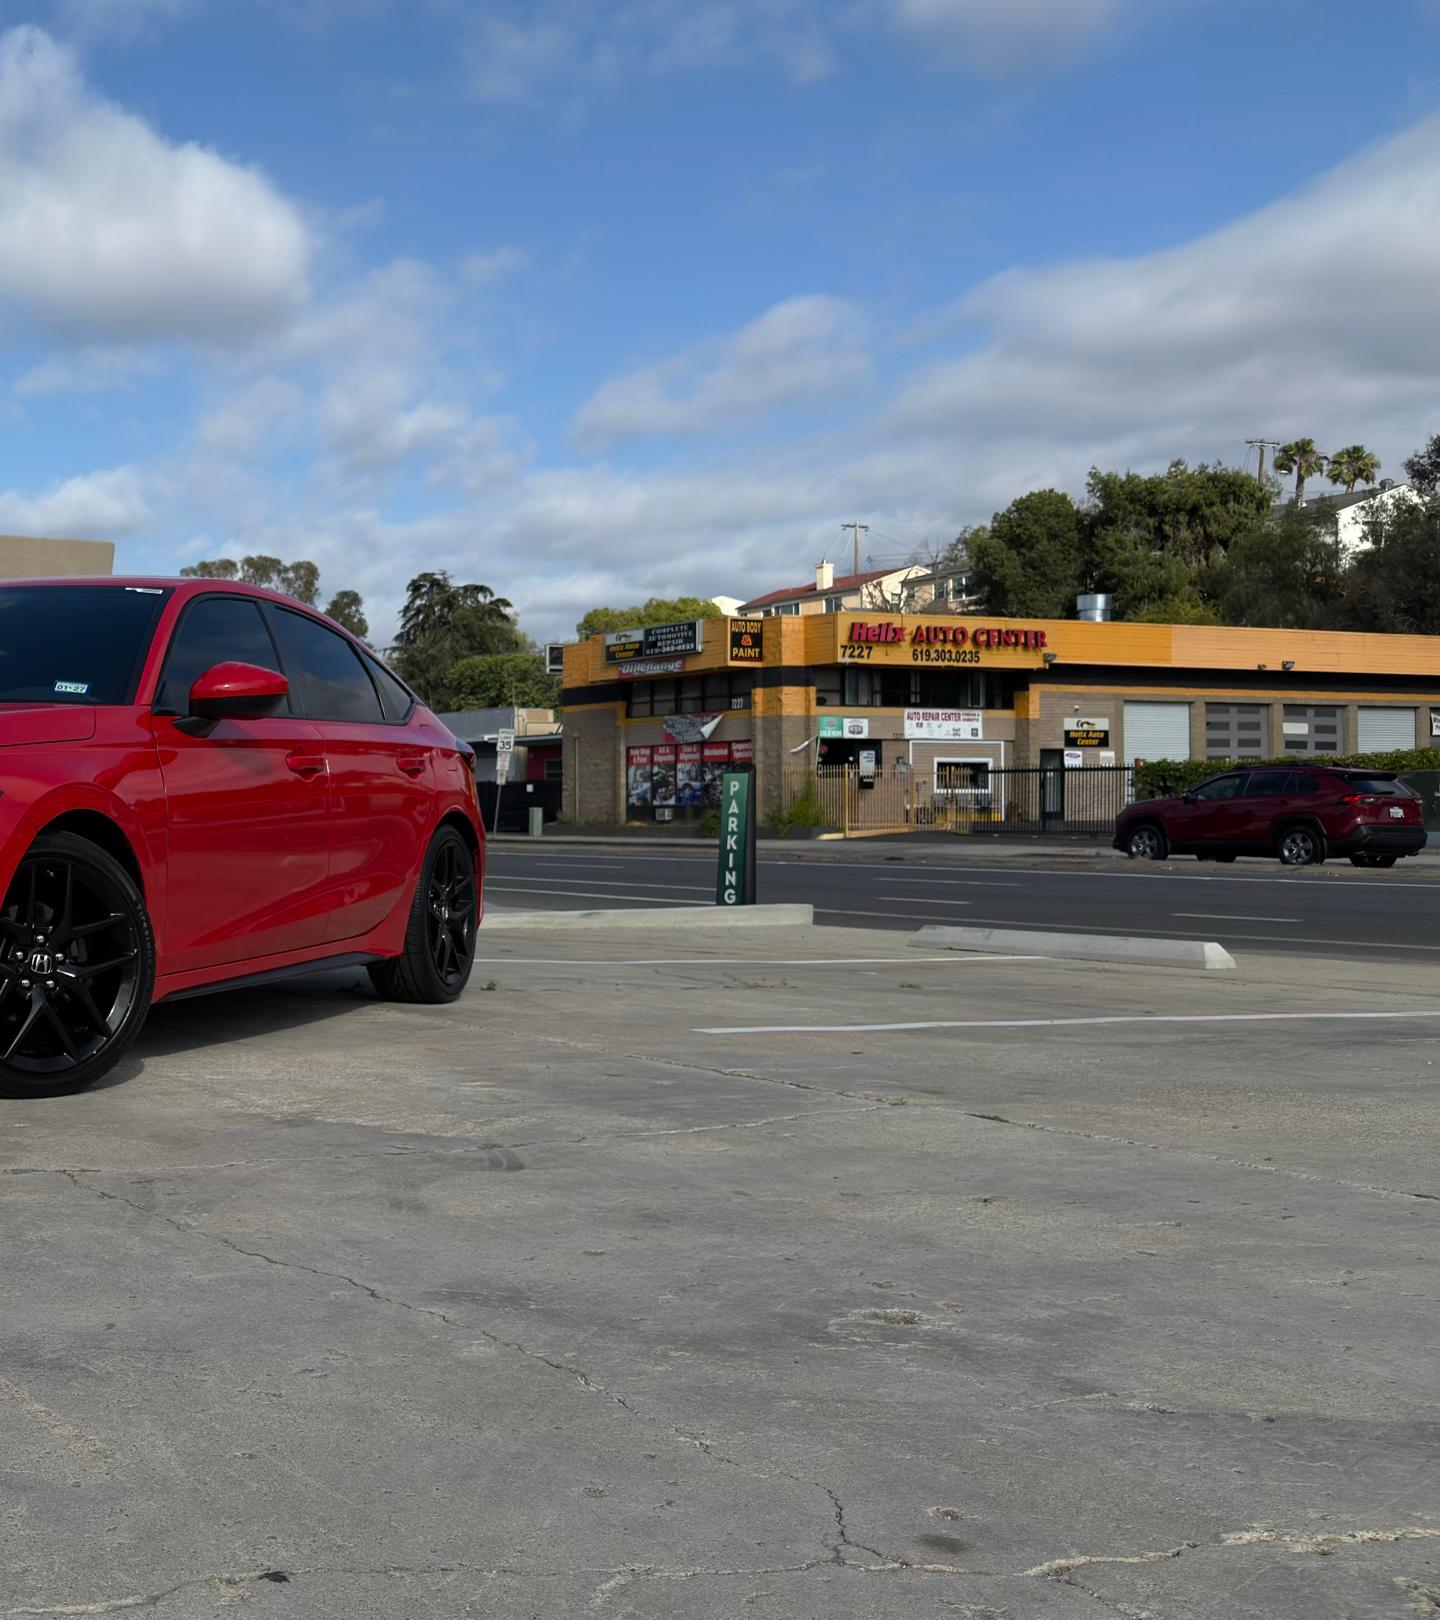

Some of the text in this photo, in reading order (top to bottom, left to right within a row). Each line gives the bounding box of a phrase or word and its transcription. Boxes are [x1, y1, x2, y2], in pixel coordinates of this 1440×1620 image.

[651, 625, 689, 634] COMPLETE
[731, 622, 761, 633] AUTO BODY
[648, 630, 693, 641] AUTOMOTIVE
[741, 634, 752, 646] &
[849, 622, 1048, 649] Helix AUTO CENTER
[657, 638, 683, 647] REPAIR
[732, 647, 760, 658] PAINT
[840, 645, 873, 659] 7227
[912, 648, 980, 663] 619.303.0235
[907, 712, 961, 721] AUTO REPAIR CENTER
[499, 741, 511, 750] 35
[724, 781, 739, 904] PARKING
